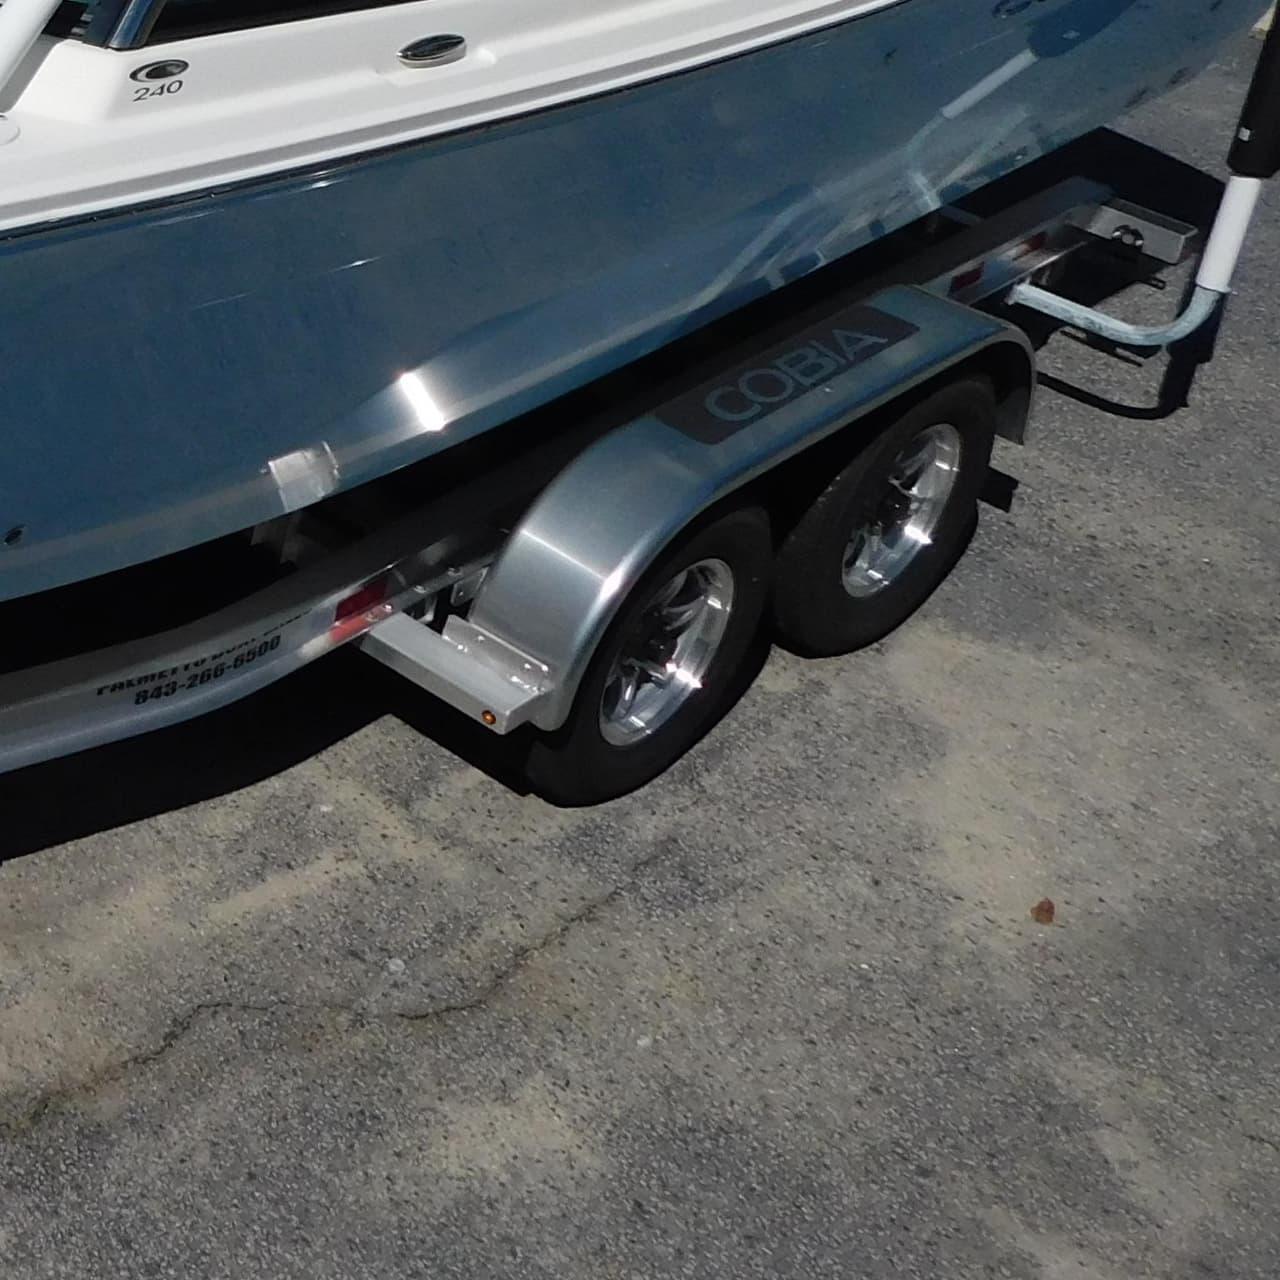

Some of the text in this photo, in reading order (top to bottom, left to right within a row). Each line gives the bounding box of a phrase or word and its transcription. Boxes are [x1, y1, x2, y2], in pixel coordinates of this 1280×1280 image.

[133, 79, 184, 103] 240
[704, 328, 890, 421] COBIA
[134, 634, 282, 705] 843-266-6500
